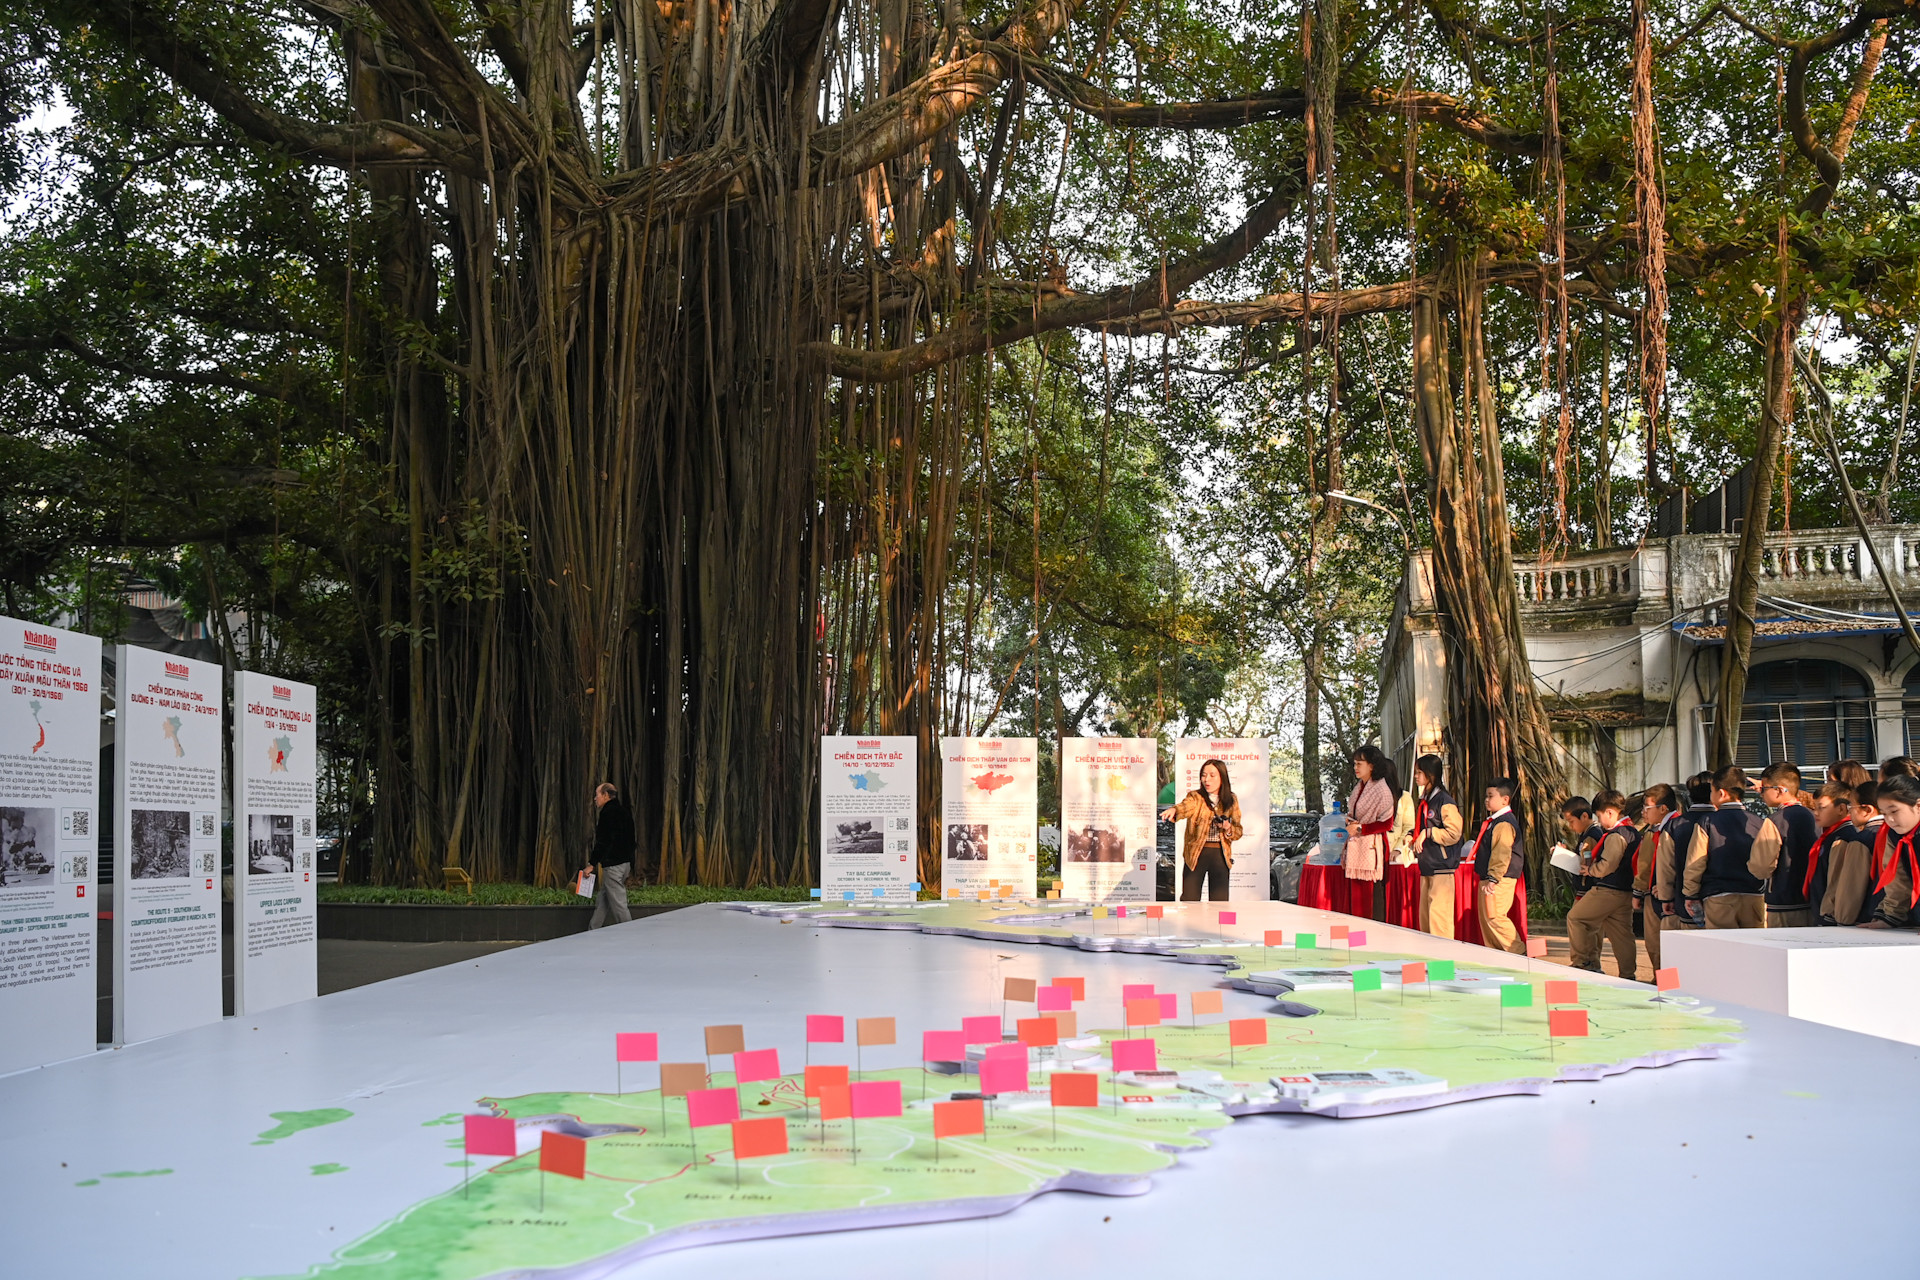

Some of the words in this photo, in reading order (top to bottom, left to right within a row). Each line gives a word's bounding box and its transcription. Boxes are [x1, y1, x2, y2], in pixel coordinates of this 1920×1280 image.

[53, 662, 70, 675] CÔNG
[16, 672, 35, 683] XUÂN
[53, 678, 71, 689] THÂN
[73, 682, 88, 692] 1968
